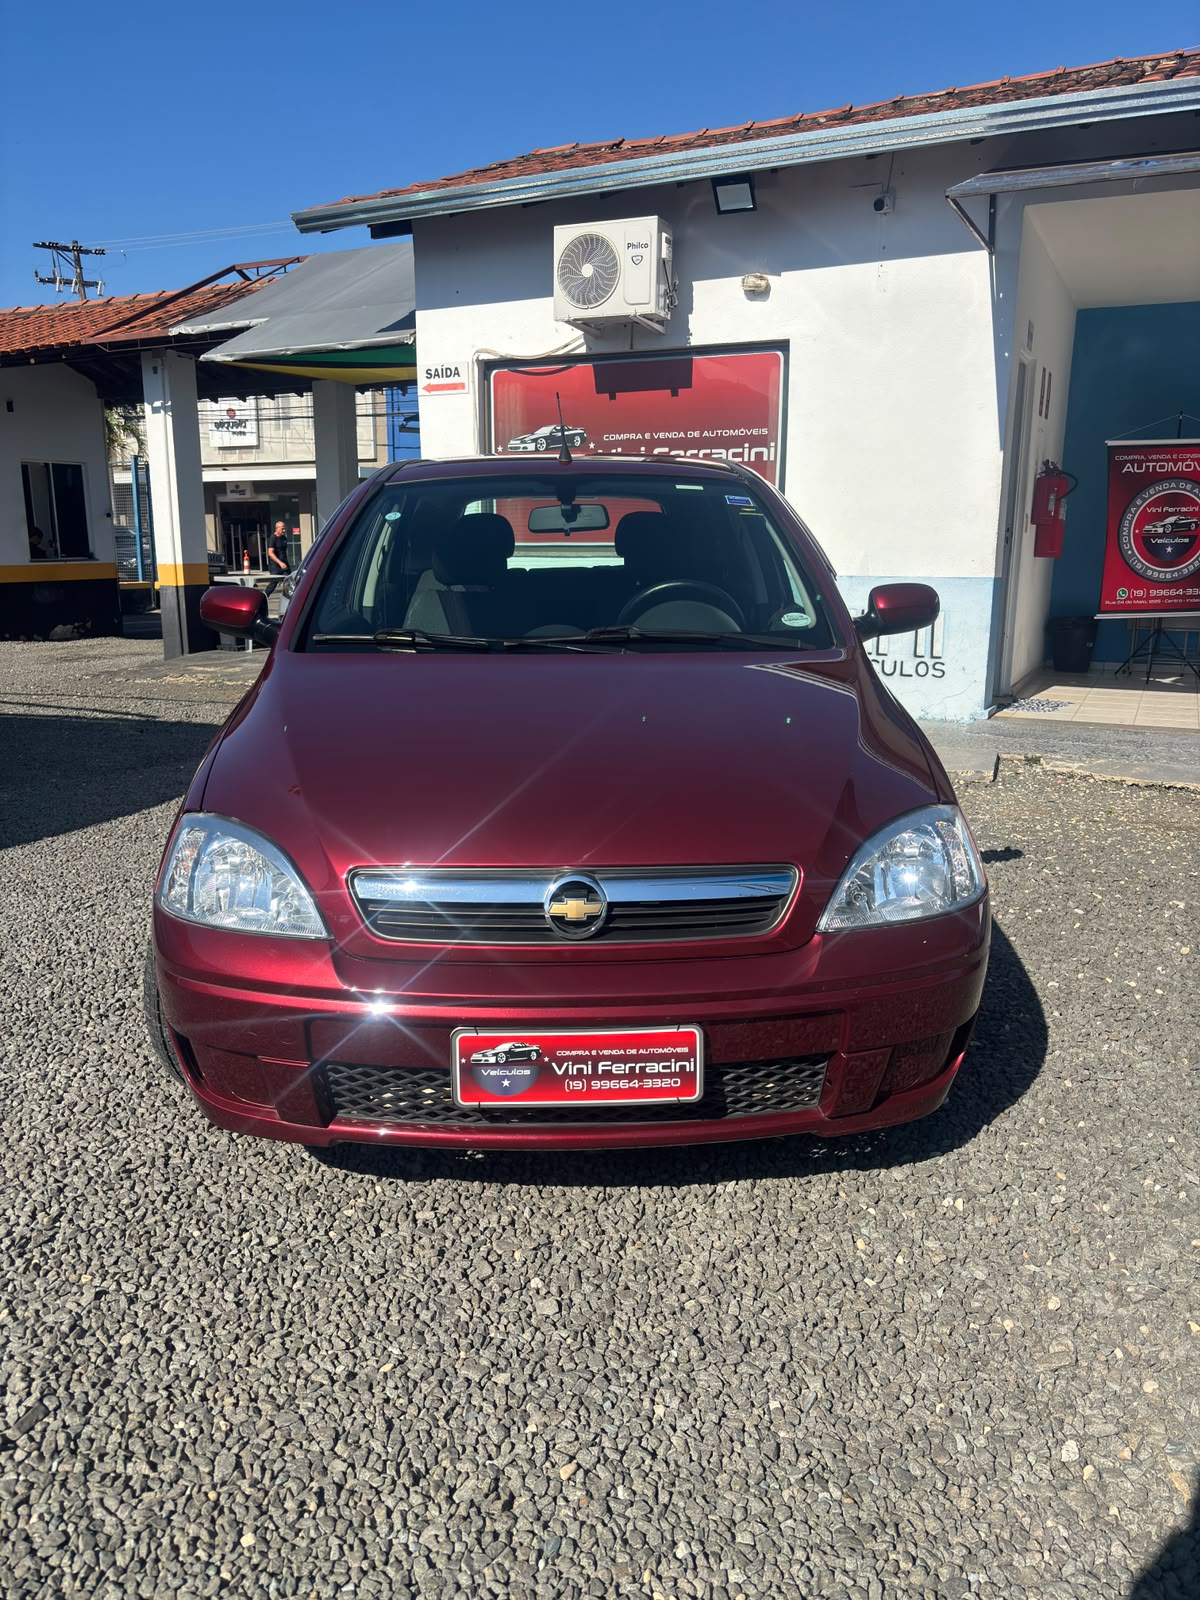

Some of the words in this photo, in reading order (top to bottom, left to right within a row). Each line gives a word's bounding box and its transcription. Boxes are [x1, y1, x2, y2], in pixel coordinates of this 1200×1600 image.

[627, 242, 649, 250] Philco
[425, 364, 461, 380] SAÍDA
[603, 433, 643, 441] COMPRA
[644, 432, 651, 440] E
[652, 431, 686, 439] VENDA
[687, 430, 701, 438] DE
[702, 427, 769, 438] AUTOMÓVEIS
[1123, 507, 1137, 549] COMPRA
[1142, 482, 1177, 499] VENDA
[1179, 482, 1192, 491] DE
[1163, 505, 1199, 513] Ferracini
[1130, 557, 1145, 573] (19)
[1130, 588, 1147, 599] (19)
[638, 1046, 689, 1054] AUTOMÓVEIS
[481, 1068, 531, 1076] Veículos
[551, 1061, 592, 1076] Vini
[598, 1058, 695, 1075] Ferracini
[565, 1078, 587, 1092] (19)
[591, 1078, 681, 1090] 99664-3320
